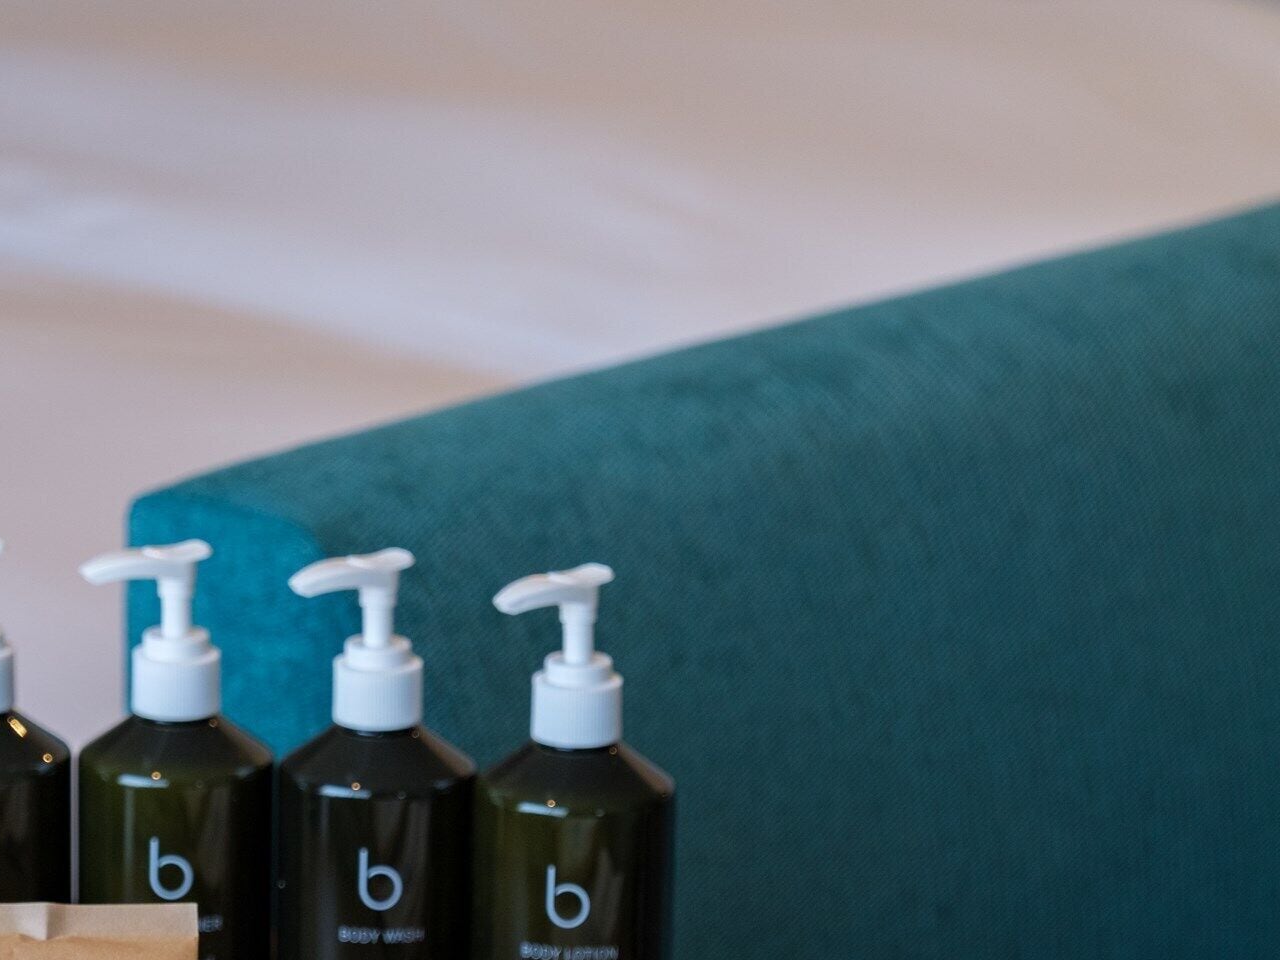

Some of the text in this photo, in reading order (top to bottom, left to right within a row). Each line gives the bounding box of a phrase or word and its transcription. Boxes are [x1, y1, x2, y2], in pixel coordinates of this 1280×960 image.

[148, 836, 195, 901] b
[357, 847, 404, 912] b
[545, 863, 591, 930] b
